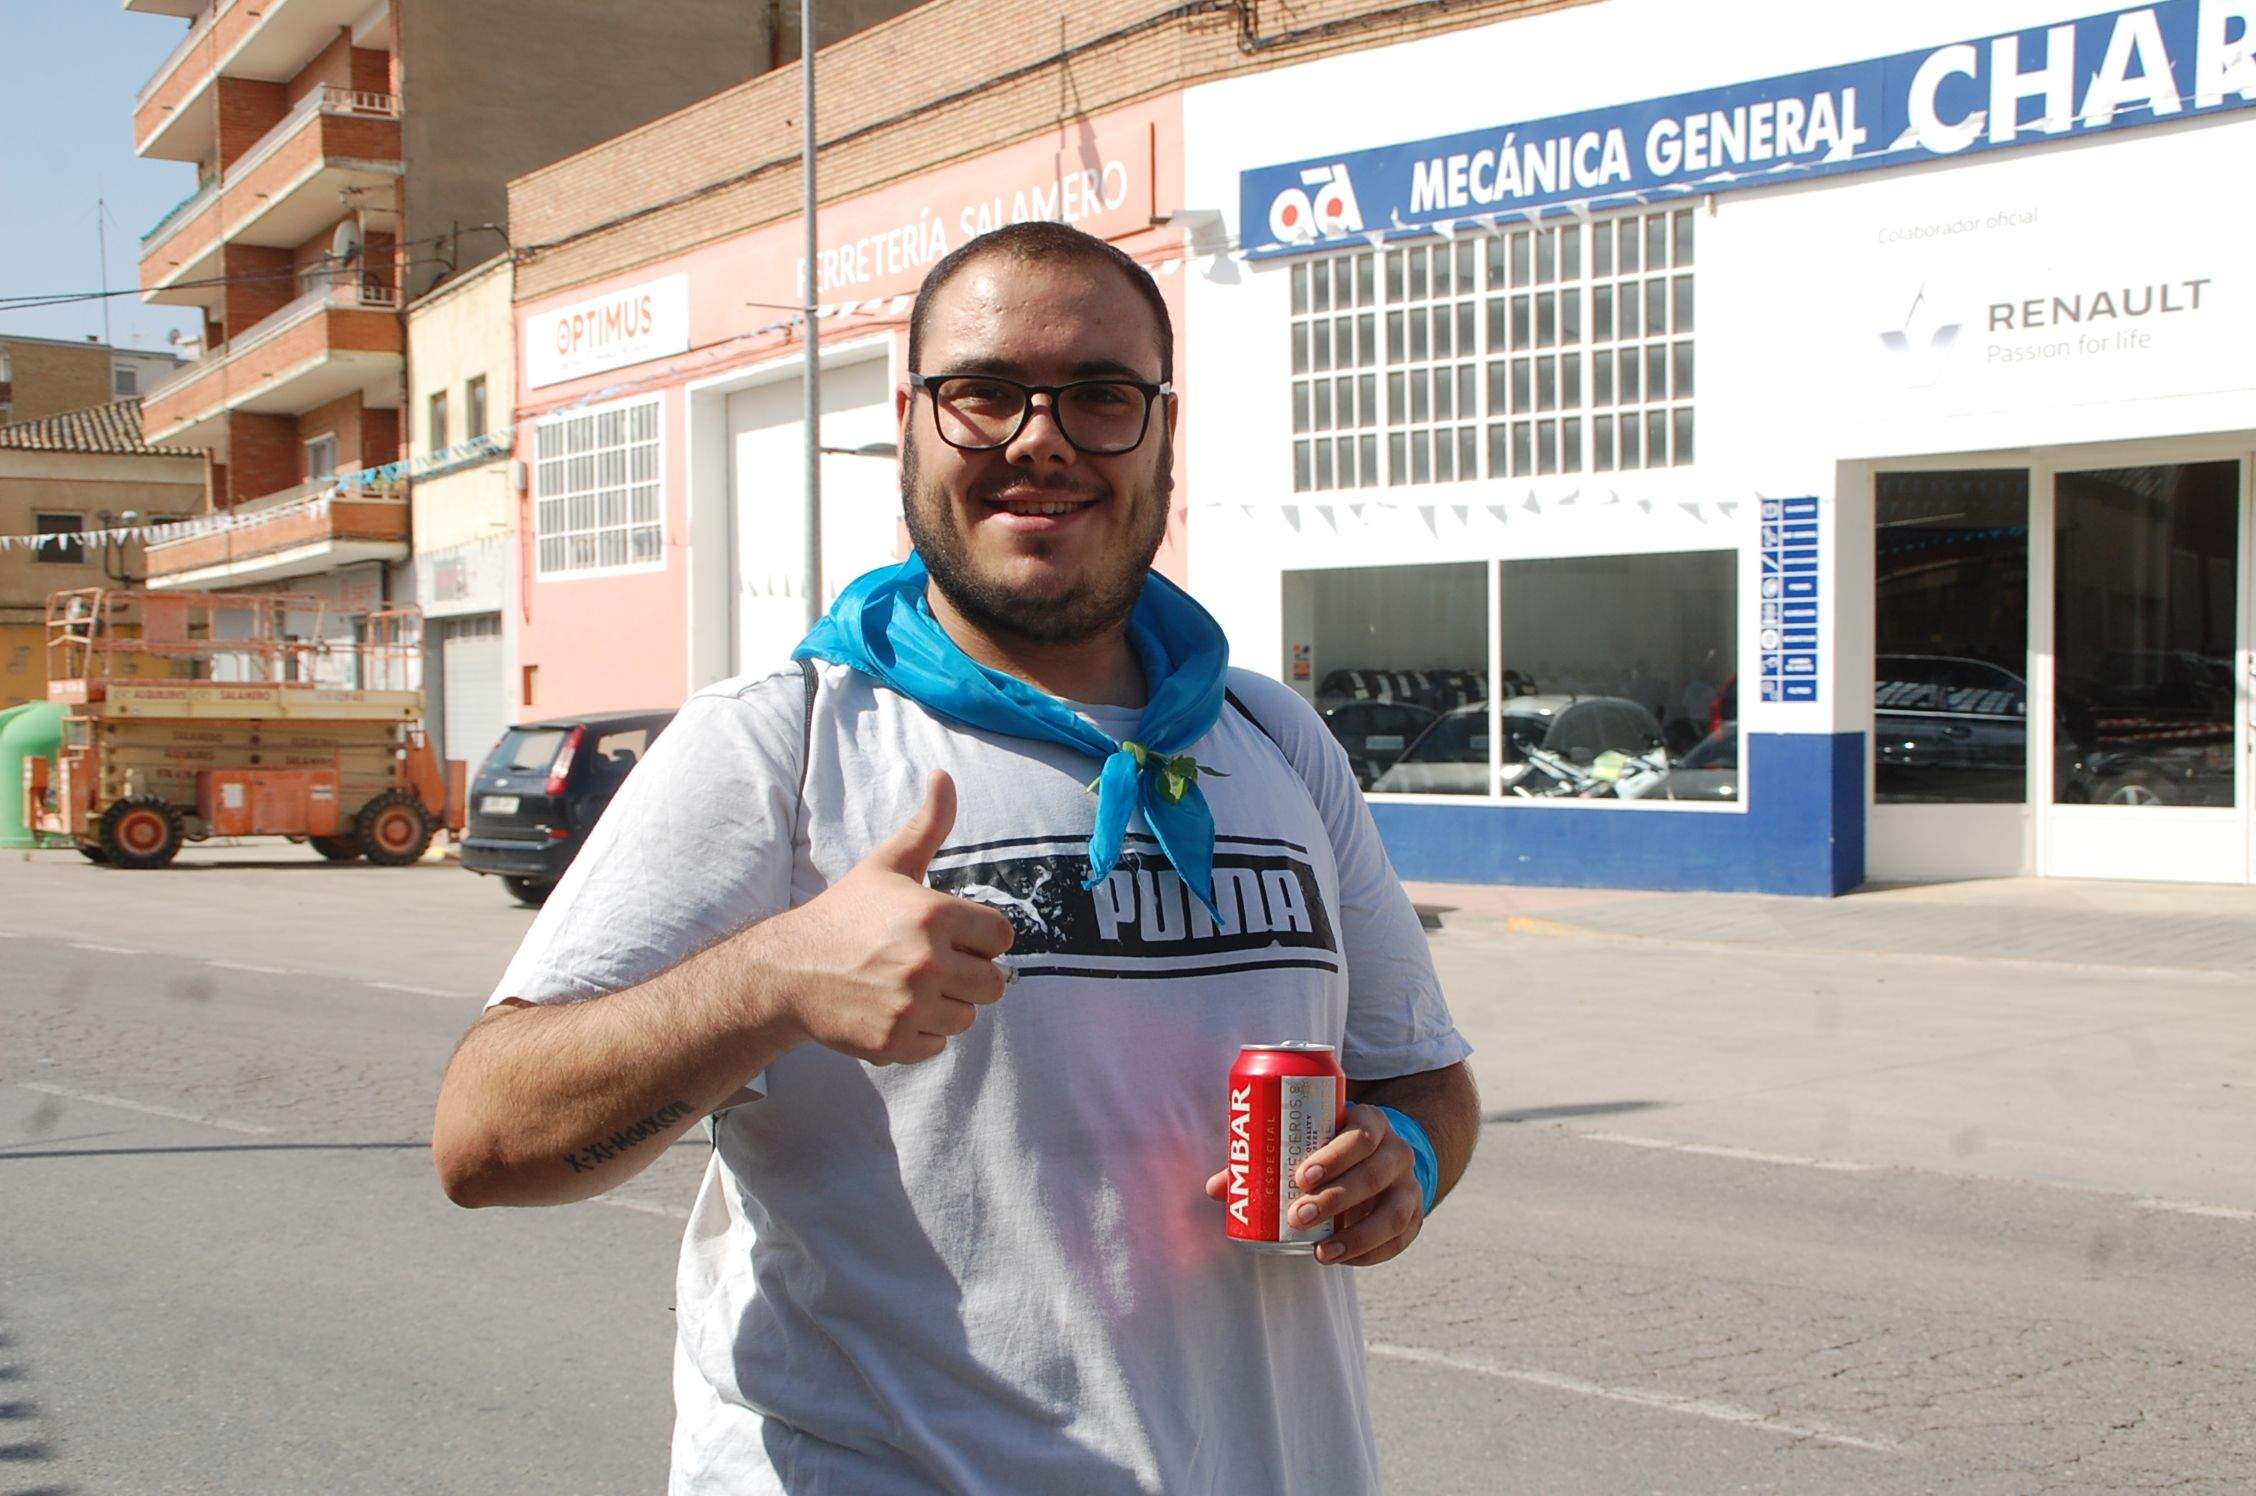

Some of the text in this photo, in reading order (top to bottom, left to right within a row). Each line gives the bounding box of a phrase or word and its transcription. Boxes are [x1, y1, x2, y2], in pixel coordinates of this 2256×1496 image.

[1410, 132, 1631, 214] MECÁNICA
[1645, 87, 1867, 177] GENERAL
[1878, 206, 2039, 245] Colaborador oficial
[556, 295, 652, 355] OPTIMUS
[1987, 277, 2212, 333] RENAULT
[1986, 328, 2152, 364] Passion for life
[1087, 868, 1313, 942] PUMA
[1229, 1083, 1252, 1226] AMBAR
[1265, 1116, 1277, 1196] ESPECIAL
